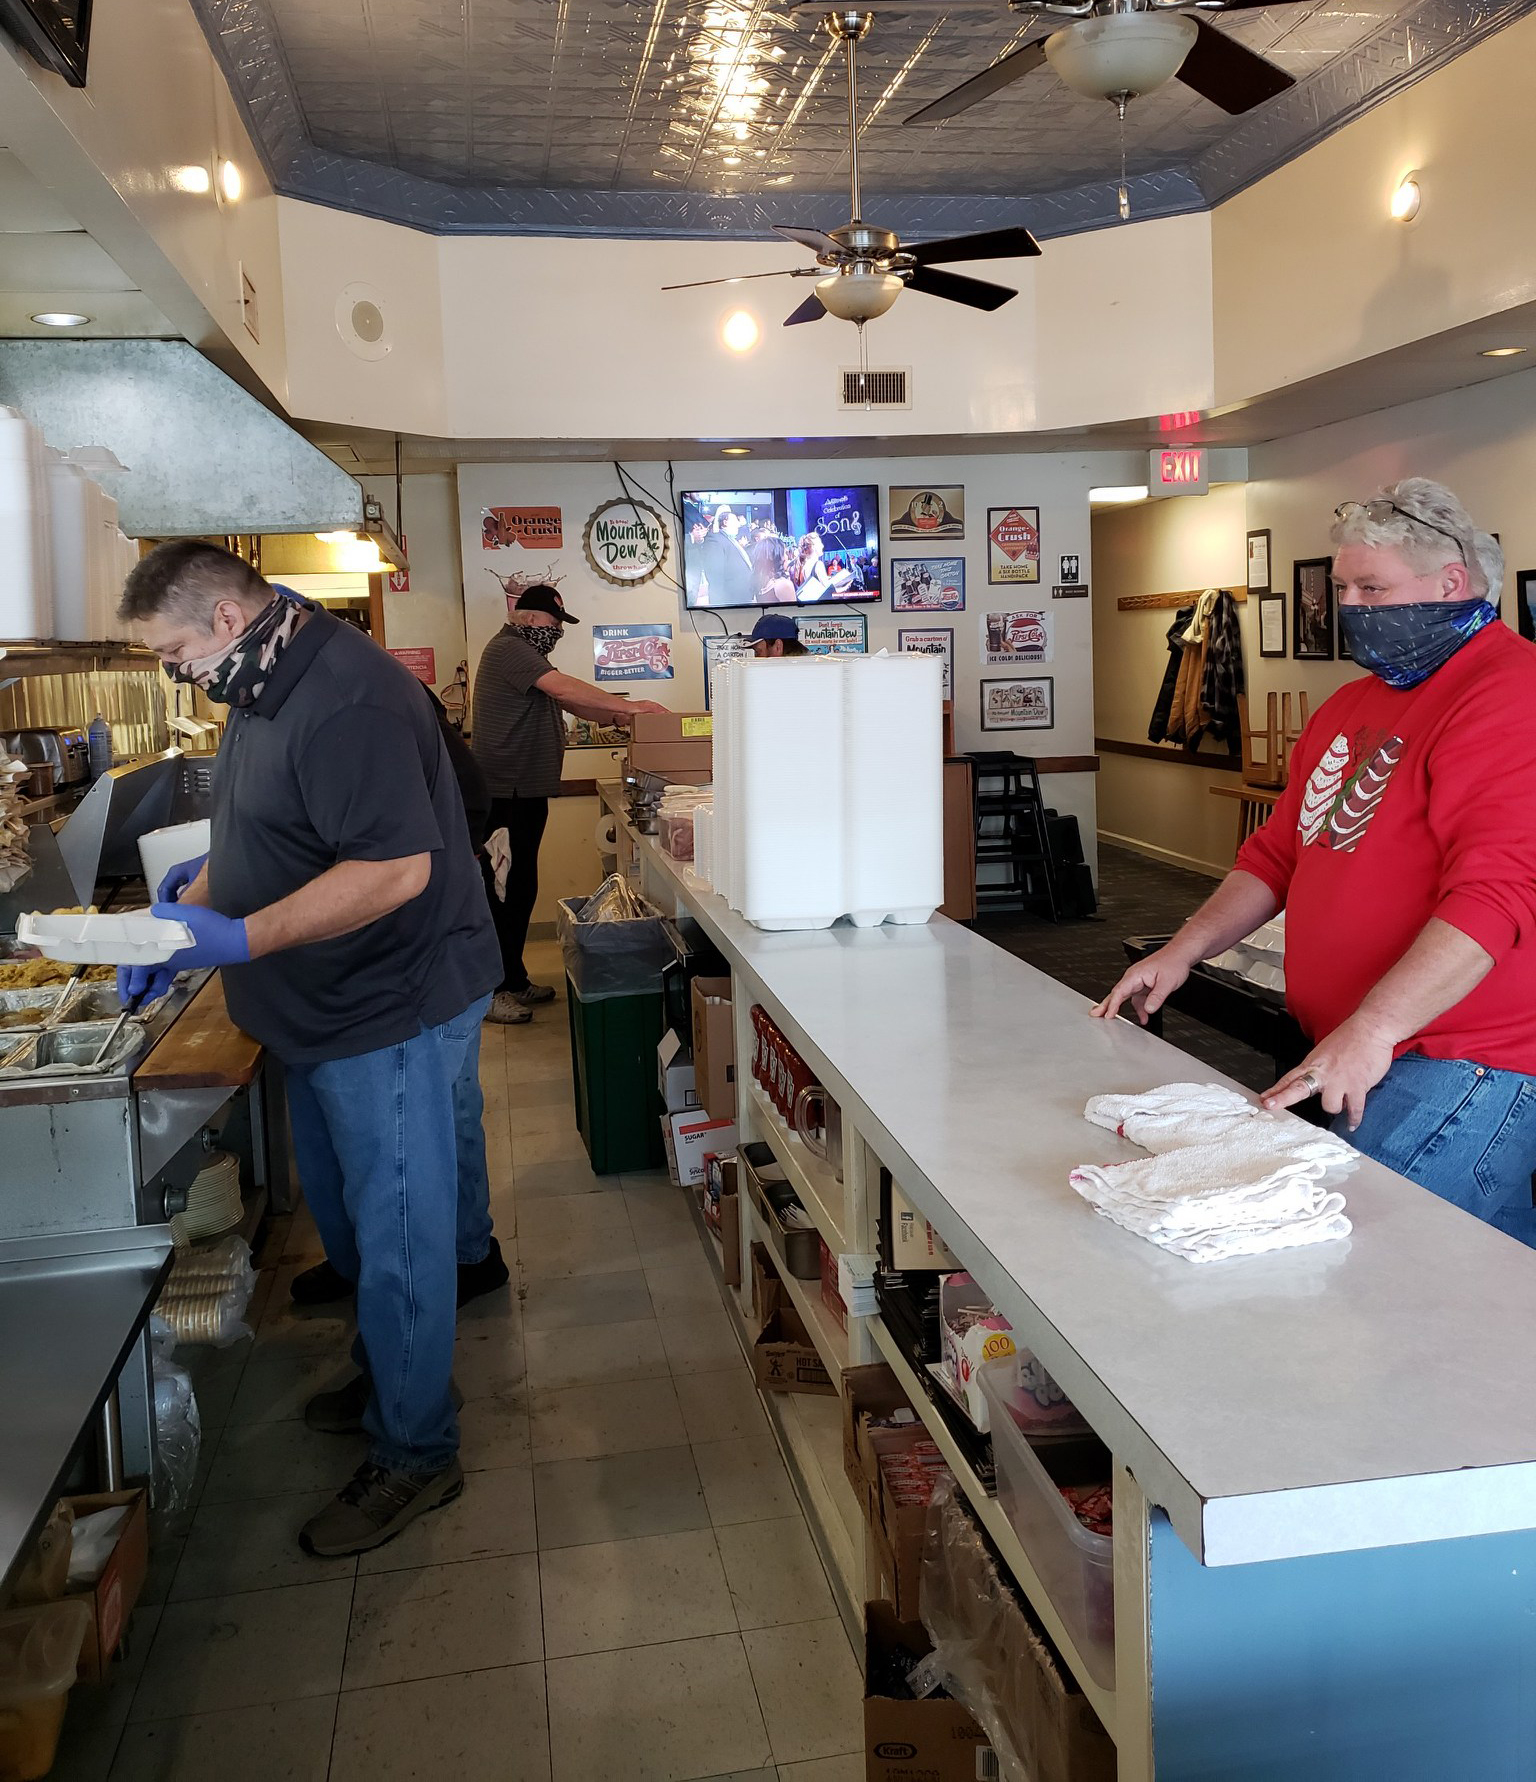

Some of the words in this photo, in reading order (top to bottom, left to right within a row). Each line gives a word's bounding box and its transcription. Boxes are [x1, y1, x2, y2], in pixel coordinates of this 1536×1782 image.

[1161, 451, 1201, 482] EXIT
[511, 514, 562, 527] Orange
[596, 520, 659, 542] Mountain
[997, 531, 1031, 542] Crush
[599, 542, 638, 564] Dew
[602, 628, 629, 637] DRINK
[804, 627, 838, 640] Mountain
[838, 627, 857, 638] Dew
[906, 643, 946, 653] Mountain
[600, 666, 645, 676] BIGGER-BETTER
[684, 1132, 705, 1141] SUGAR
[984, 1336, 1010, 1358] 100
[796, 1357, 812, 1367] HOT
[882, 1746, 909, 1756] Kraft
